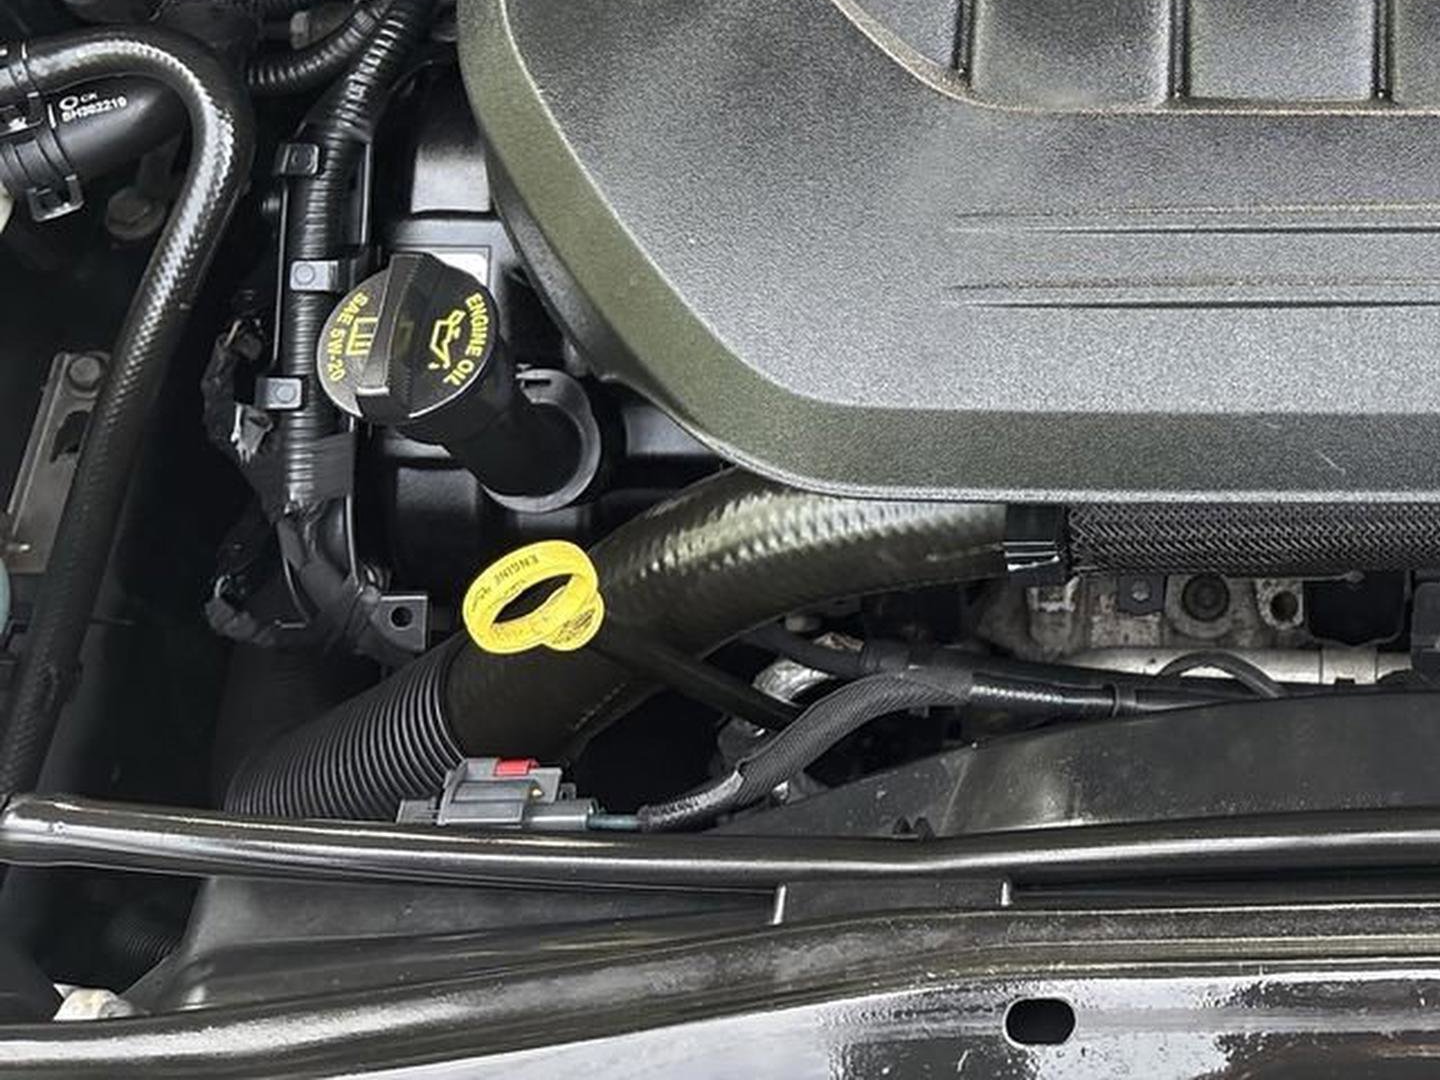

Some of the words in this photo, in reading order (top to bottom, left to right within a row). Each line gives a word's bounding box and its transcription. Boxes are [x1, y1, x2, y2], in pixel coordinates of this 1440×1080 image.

[336, 292, 370, 326] SAE
[465, 292, 489, 358] ENGINE
[327, 327, 347, 383] 5W-20
[443, 358, 476, 387] OIL
